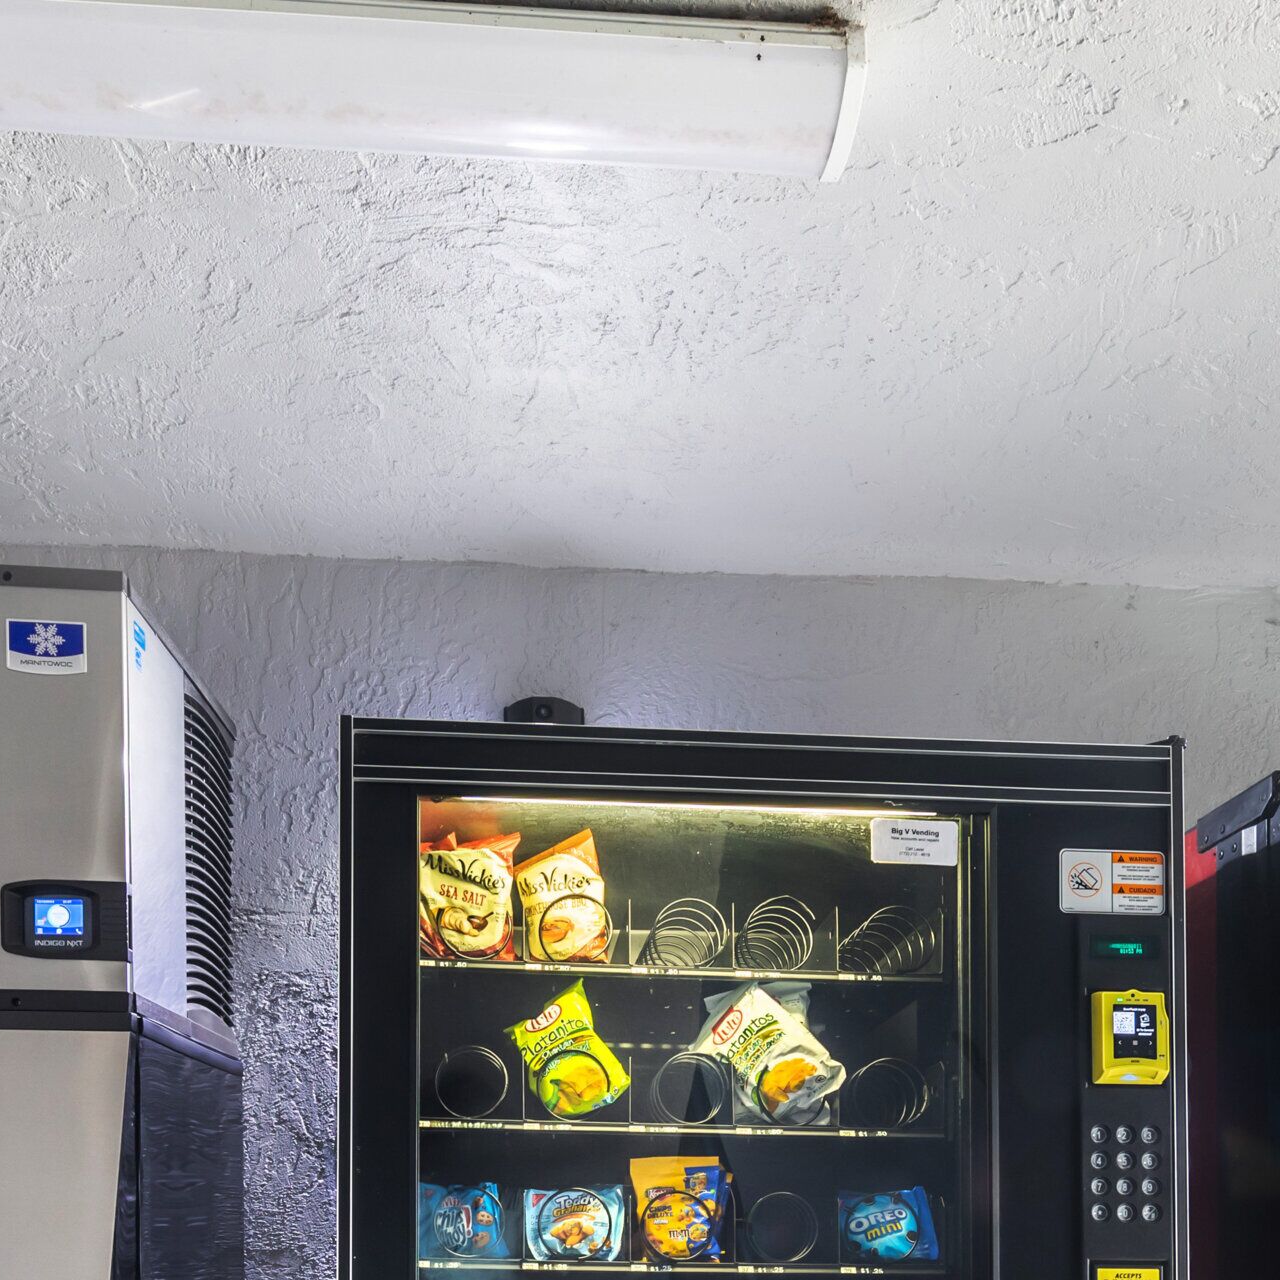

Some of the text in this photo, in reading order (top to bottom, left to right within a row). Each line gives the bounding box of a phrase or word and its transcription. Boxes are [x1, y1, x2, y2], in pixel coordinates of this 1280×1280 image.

[20, 658, 74, 669] MANITOWOC
[891, 827, 903, 836] Big
[911, 829, 940, 838] Vending
[423, 853, 505, 894] Miss Vickie's
[519, 866, 591, 898] Miss Vickie's
[438, 883, 487, 907] SEA SALT
[66, 940, 84, 948] NXT
[520, 1019, 586, 1060] Platanito
[556, 1193, 599, 1211] Teddy
[648, 1204, 673, 1213] CHIPS
[849, 1208, 907, 1233] OREO
[866, 1220, 903, 1241] mini
